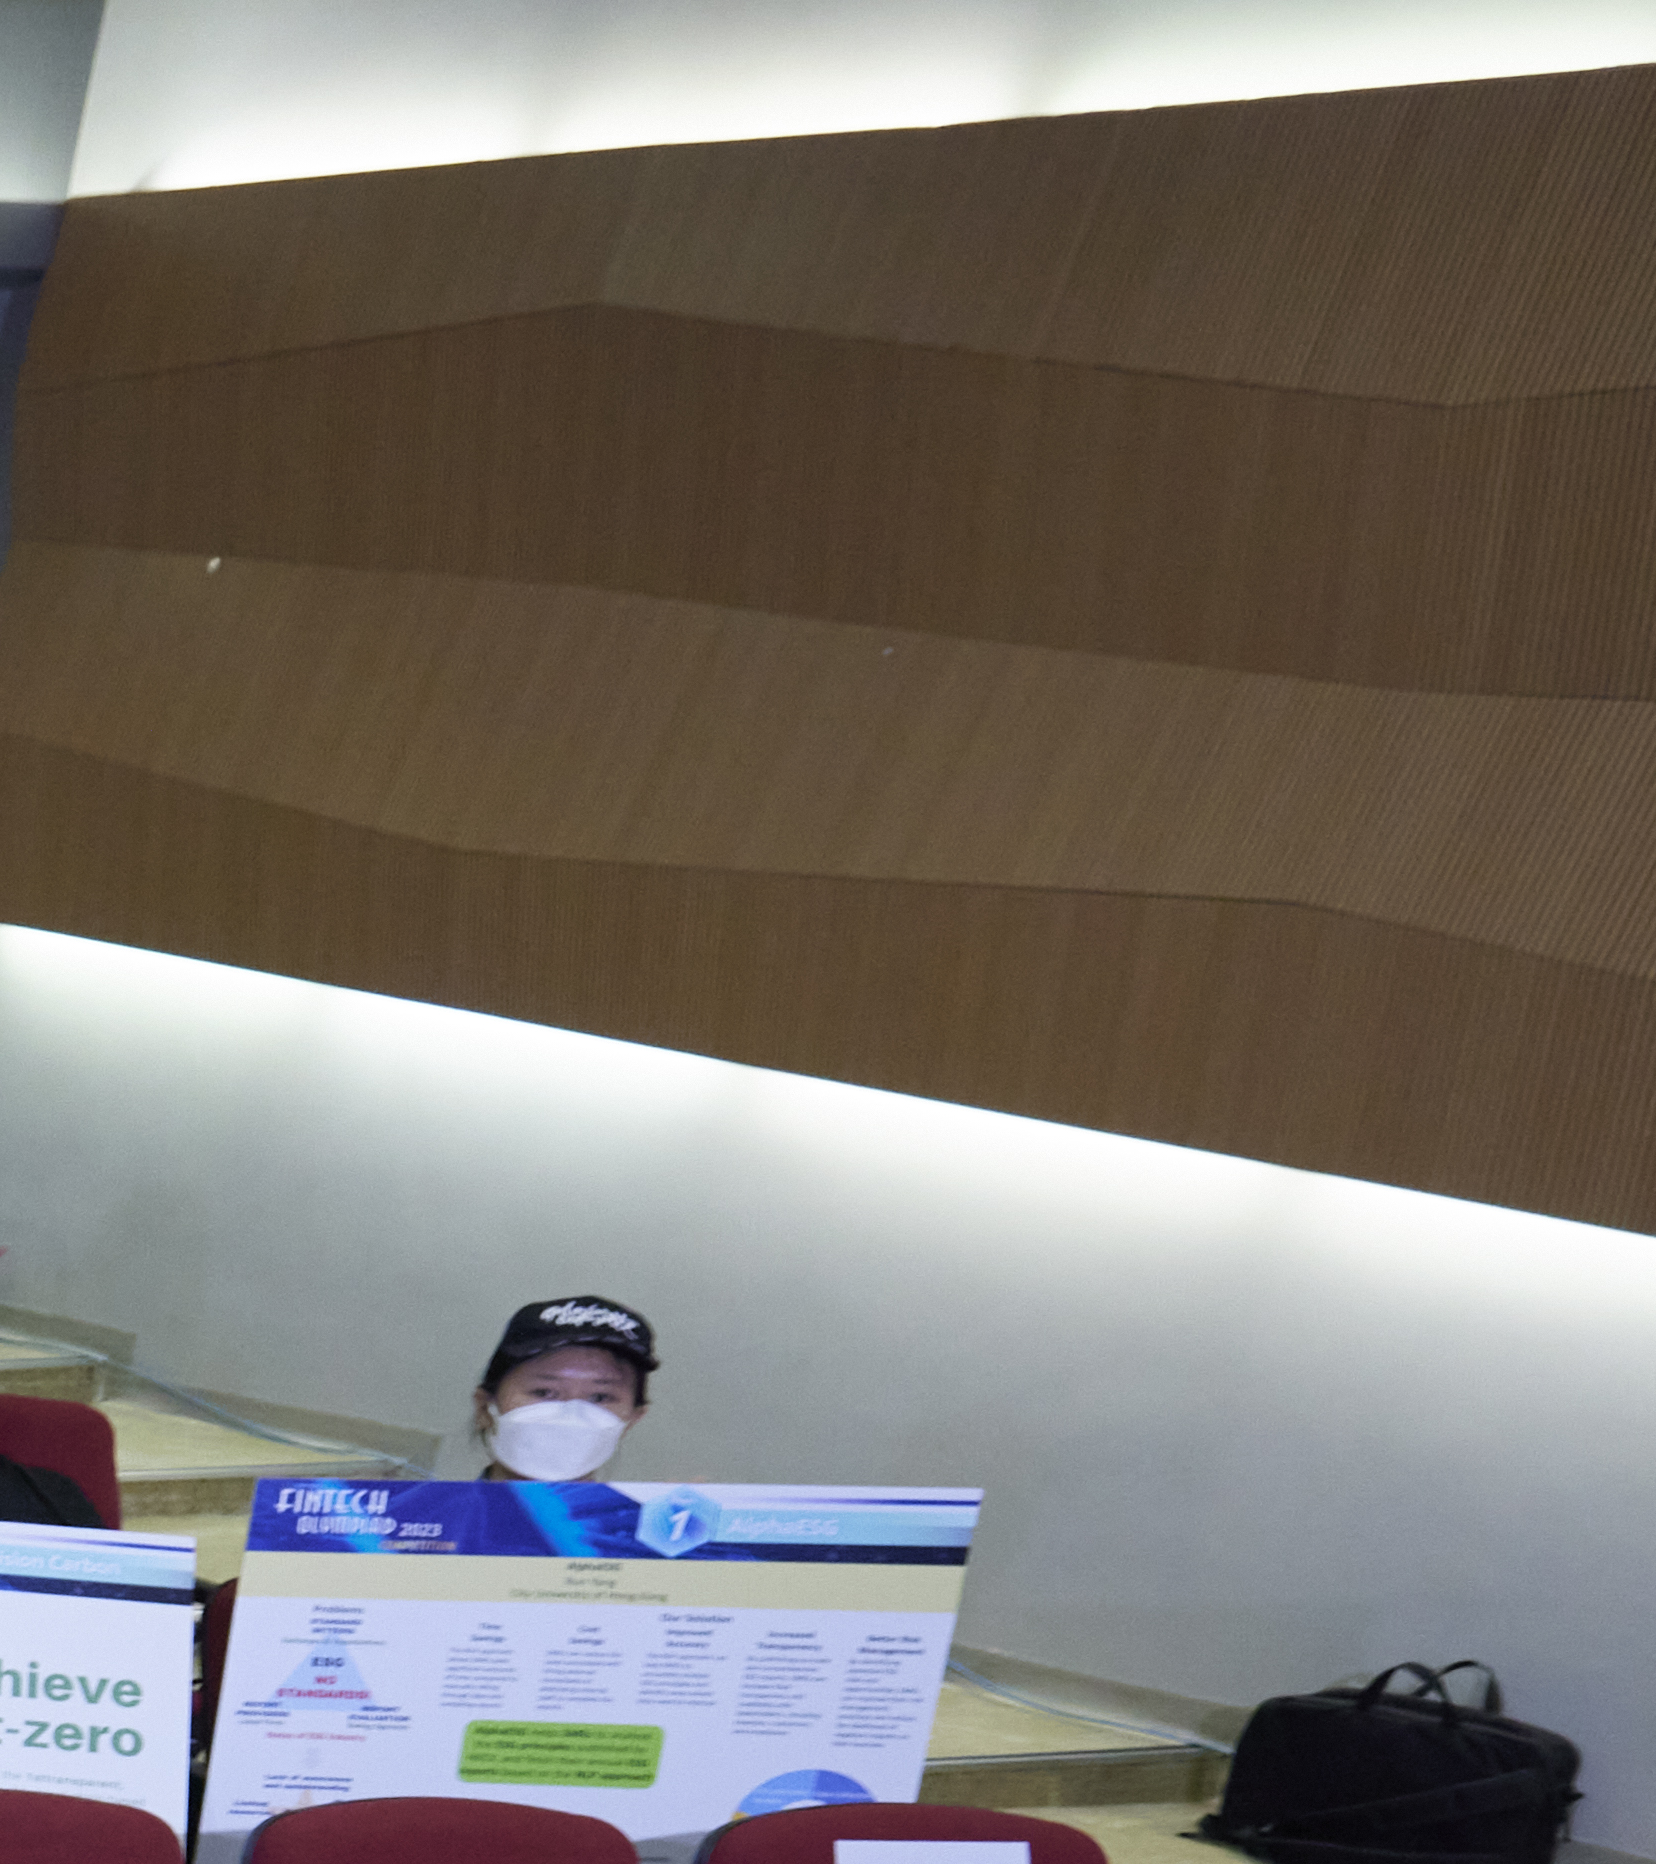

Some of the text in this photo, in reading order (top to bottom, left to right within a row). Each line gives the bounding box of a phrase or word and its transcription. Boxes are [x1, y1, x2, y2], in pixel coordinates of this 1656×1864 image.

[274, 1488, 390, 1515] FINTECH
[398, 1523, 443, 1537] 2023
[670, 1510, 689, 1541] 1
[729, 1517, 840, 1537] AlphaESG
[48, 1554, 122, 1579] Carbon
